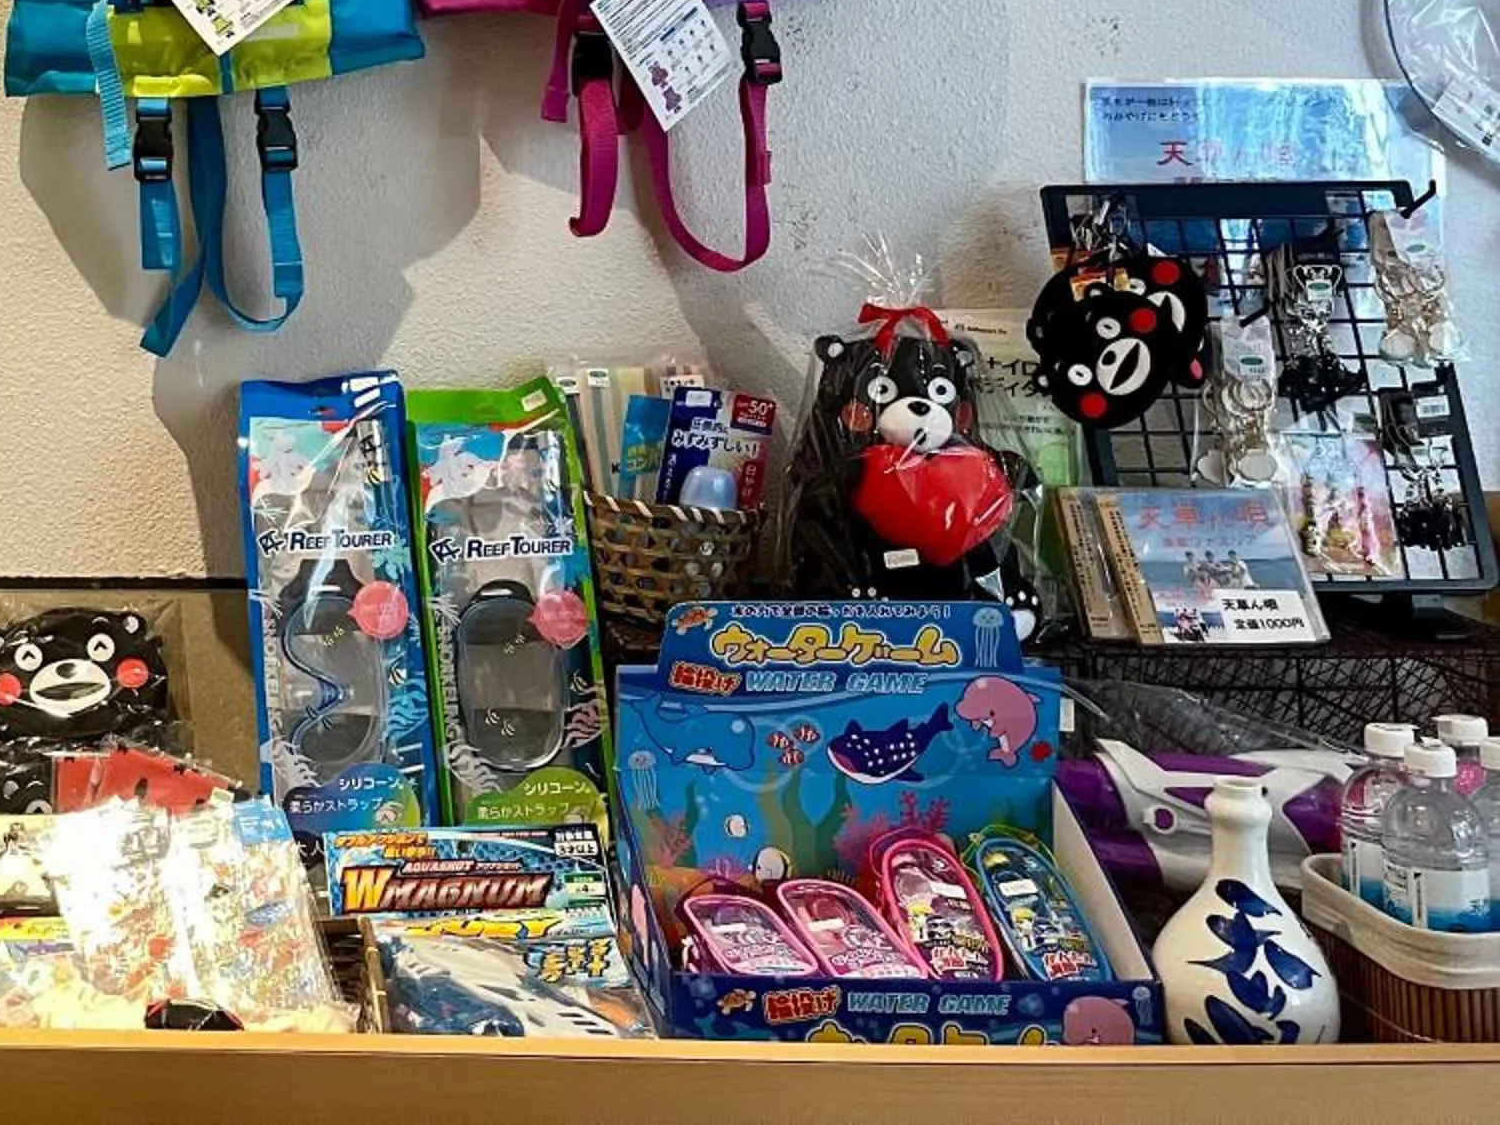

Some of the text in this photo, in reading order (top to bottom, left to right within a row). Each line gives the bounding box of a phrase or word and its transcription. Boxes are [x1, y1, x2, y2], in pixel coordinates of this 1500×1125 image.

[712, 623, 961, 666] ウォーターゲーム
[745, 671, 836, 692] WATER
[846, 671, 928, 693] GAME
[380, 877, 549, 909] MAGNUM
[848, 991, 931, 1013] WATER
[939, 991, 1012, 1015] GAME
